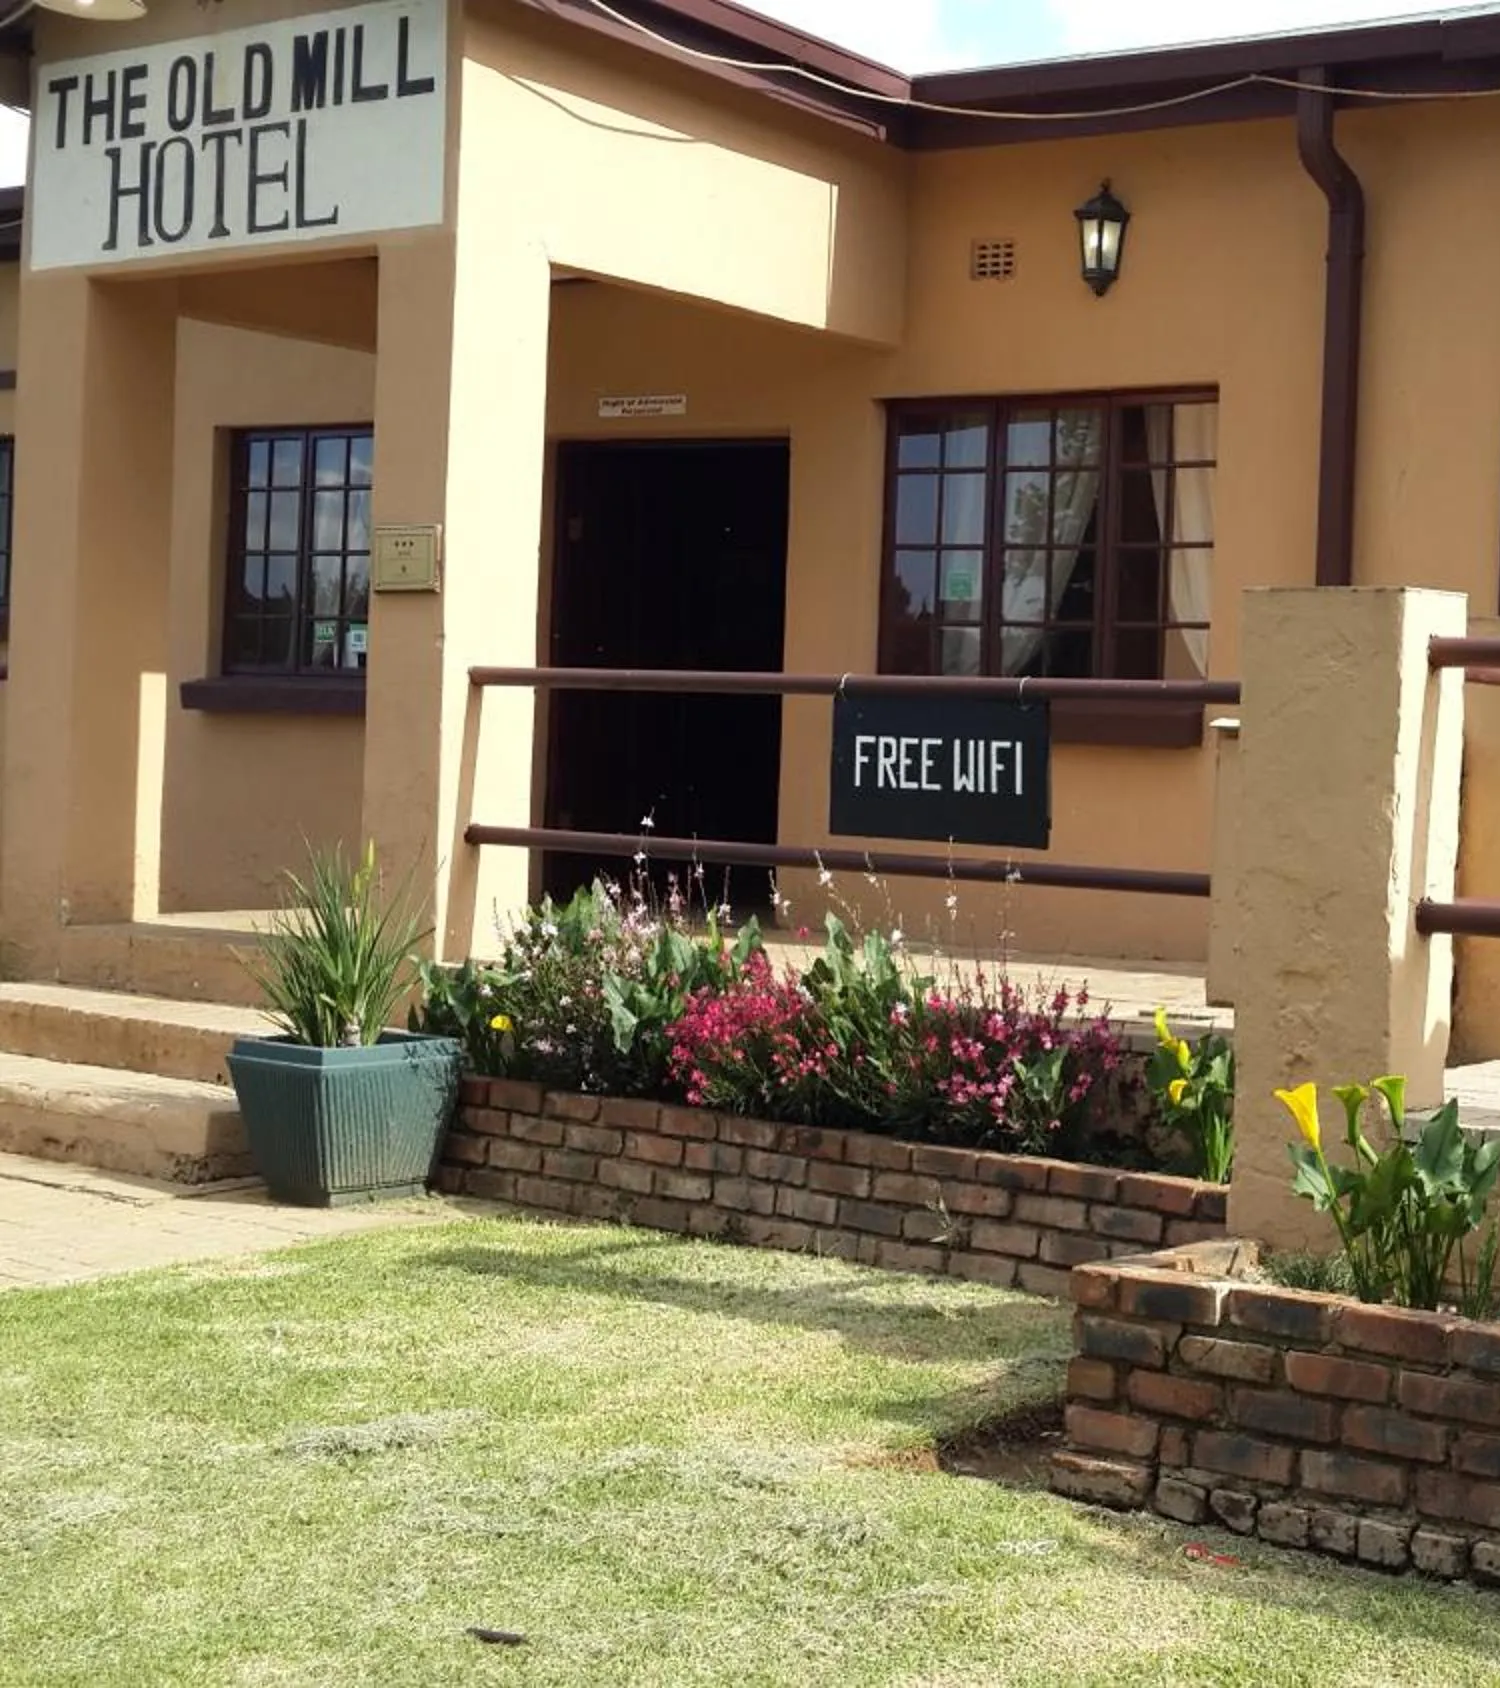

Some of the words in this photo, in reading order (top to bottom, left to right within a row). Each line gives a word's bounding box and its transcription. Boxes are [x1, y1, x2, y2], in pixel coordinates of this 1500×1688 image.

[49, 64, 149, 149] THE
[167, 42, 273, 132] OLD
[291, 15, 436, 112] MILL
[102, 118, 339, 251] HOTEL
[854, 735, 943, 791] FREE
[953, 738, 1023, 795] WIFI
